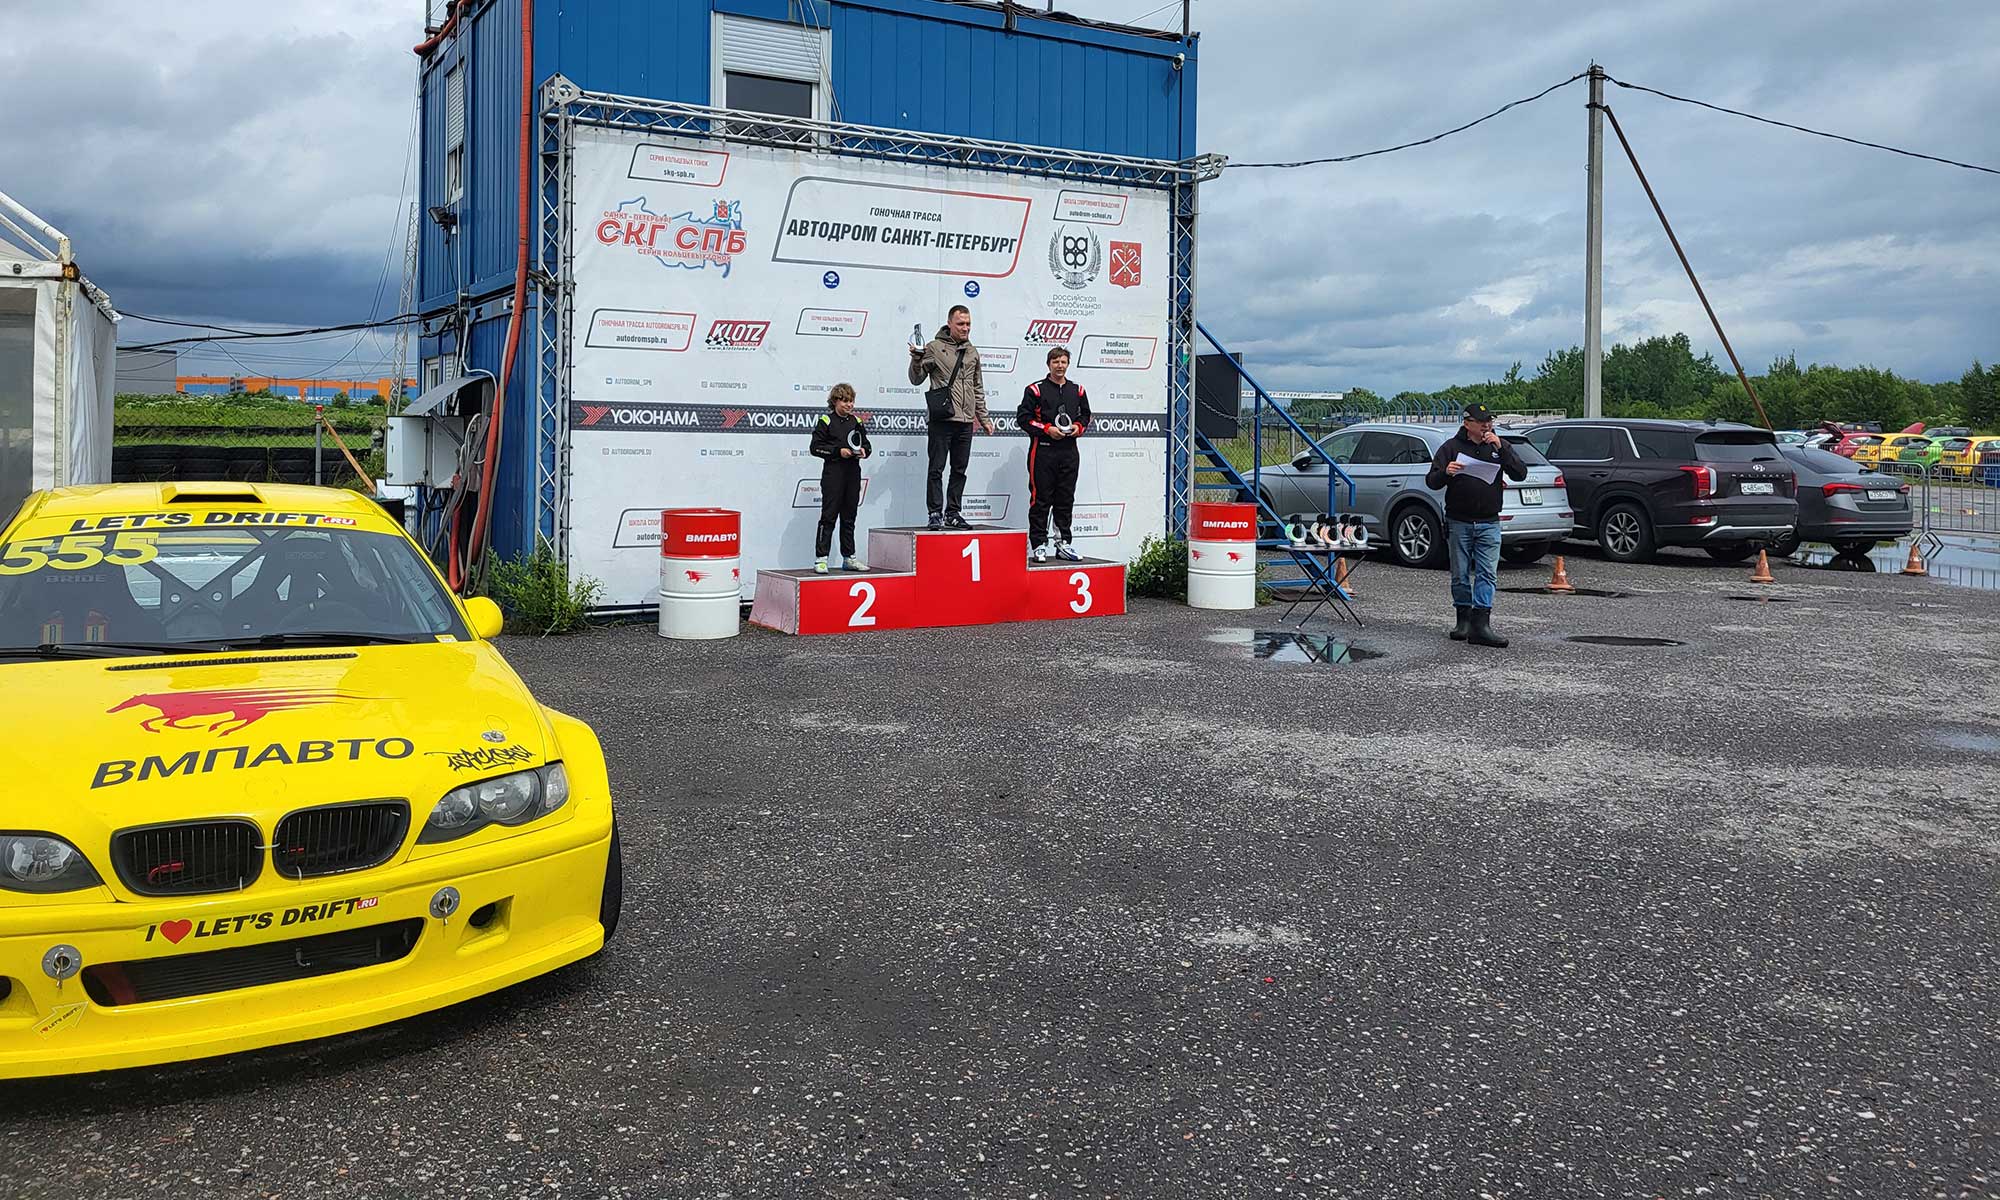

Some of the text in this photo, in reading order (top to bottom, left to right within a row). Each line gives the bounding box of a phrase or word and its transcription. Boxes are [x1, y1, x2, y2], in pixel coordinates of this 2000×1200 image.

[664, 169, 695, 179] skg-spb.ru
[870, 207, 942, 223] ГОНОЧНАЯ ТРАССА
[597, 220, 746, 253] СКГ СПБ
[786, 218, 1018, 254] АВТОДРОМ САНКТ-ПЕТЕРБУРГ
[1047, 301, 1102, 309] автомобильная
[1053, 294, 1096, 302] российская
[1054, 307, 1095, 316] федерация
[598, 319, 625, 327] ГОНОЧНАЯ
[626, 320, 645, 328] ТРАССА
[1030, 322, 1075, 339] KLOTZ
[616, 335, 668, 344] autodromspb.ru
[711, 323, 767, 342] KLOTZ
[610, 408, 700, 426] YOKOHAMA
[746, 411, 819, 428] YOKOHAM
[872, 414, 928, 429] YOKOHA
[1094, 418, 1160, 432] YOKOHAMA
[69, 512, 192, 532] LET'S
[1202, 520, 1249, 529] ВМПАВТО
[685, 533, 738, 543] ВМПАВТО
[0, 532, 160, 575] 555
[961, 538, 981, 582] 1
[1068, 571, 1093, 614] 3
[848, 581, 877, 627] 2
[90, 737, 415, 790] ВМПАВТО
[145, 925, 156, 942] I
[194, 911, 274, 938] LET'S
